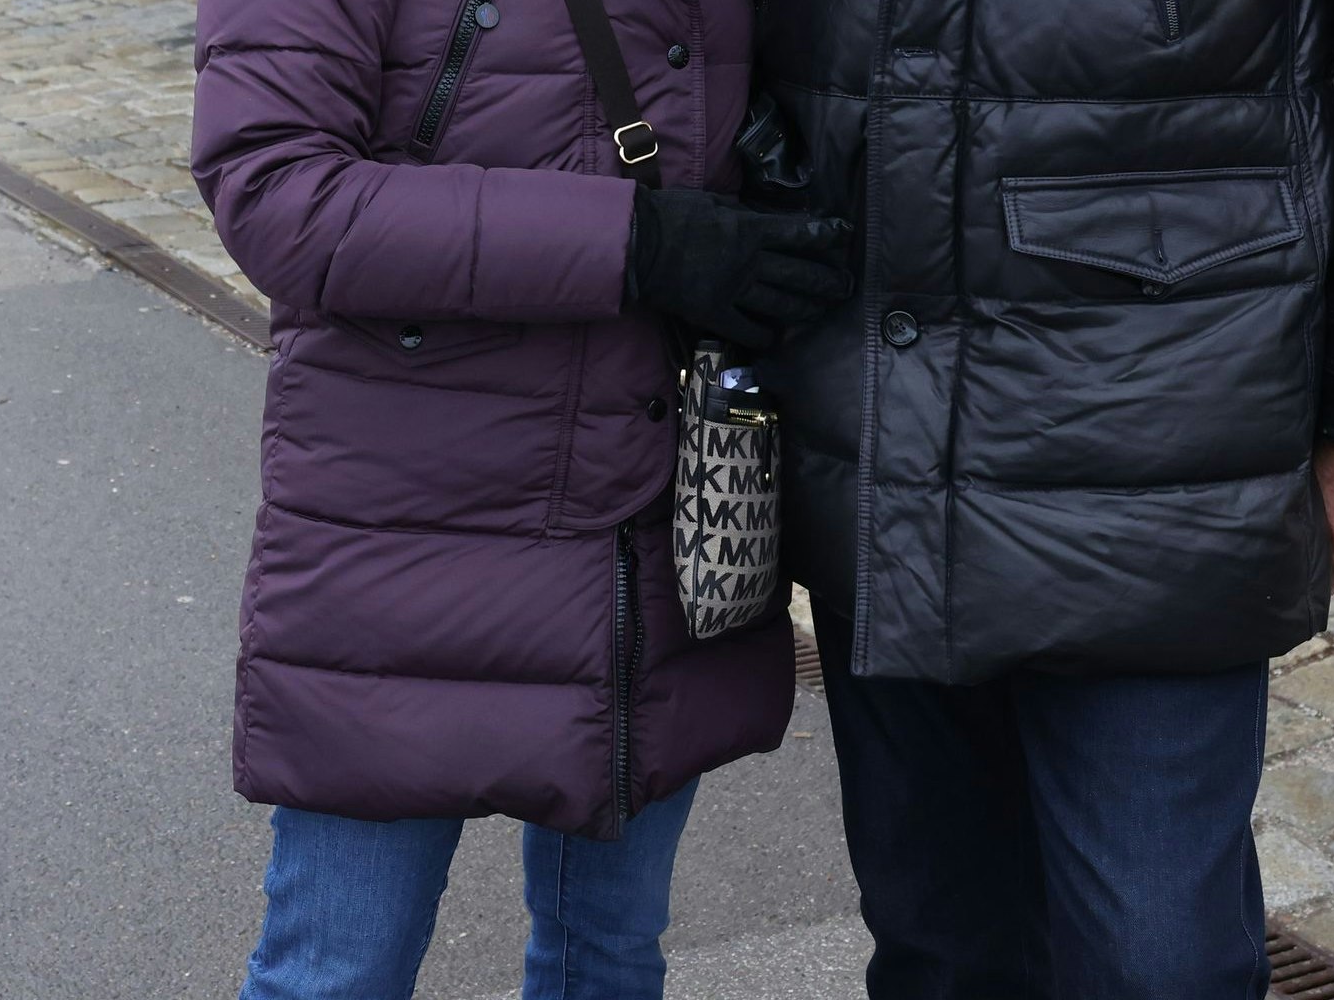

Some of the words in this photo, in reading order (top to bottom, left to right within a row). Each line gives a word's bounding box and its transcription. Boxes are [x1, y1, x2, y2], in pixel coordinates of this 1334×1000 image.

[707, 428, 748, 459] MK
[728, 465, 763, 494] MK
[746, 500, 774, 531] MK
[718, 536, 756, 567] MK
